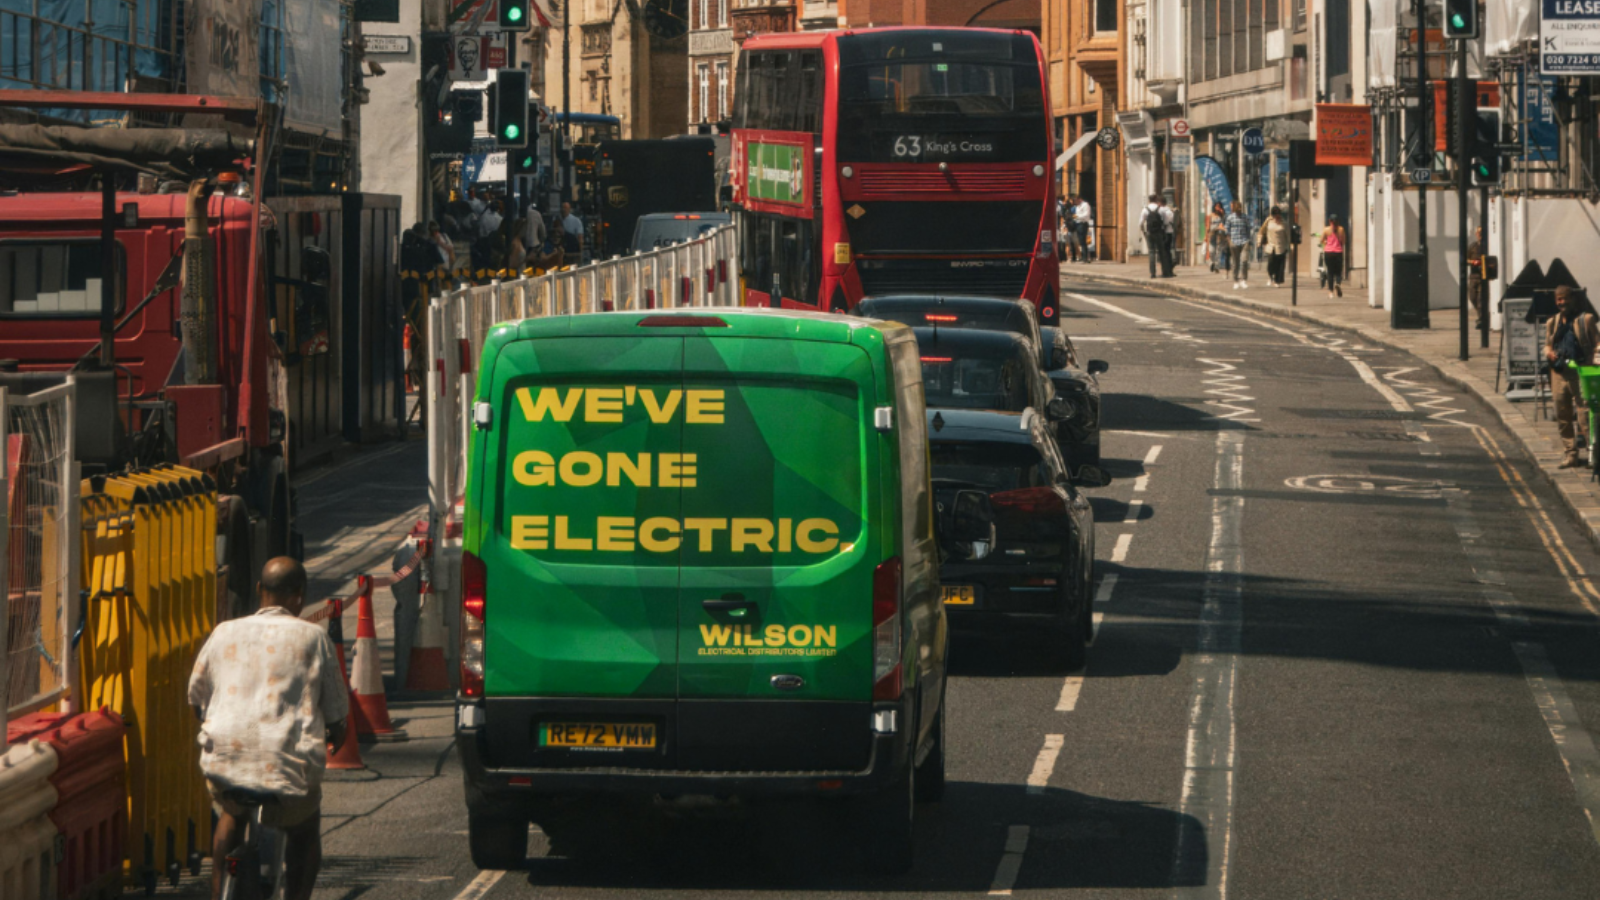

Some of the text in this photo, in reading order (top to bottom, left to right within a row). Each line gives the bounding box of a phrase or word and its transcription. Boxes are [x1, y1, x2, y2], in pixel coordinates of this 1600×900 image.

[1546, 56, 1564, 64] 020
[894, 135, 993, 157] 63 King's Cross
[1243, 135, 1264, 147] DIY
[515, 385, 725, 424] WE'VE
[512, 450, 698, 488] GONE
[510, 515, 855, 553] ELECTRIC.
[699, 624, 837, 647] WILSON
[697, 647, 746, 655] ELECTRICAL
[748, 648, 804, 656] DISTRIBUTORS
[551, 724, 653, 745] RE72 VMW
